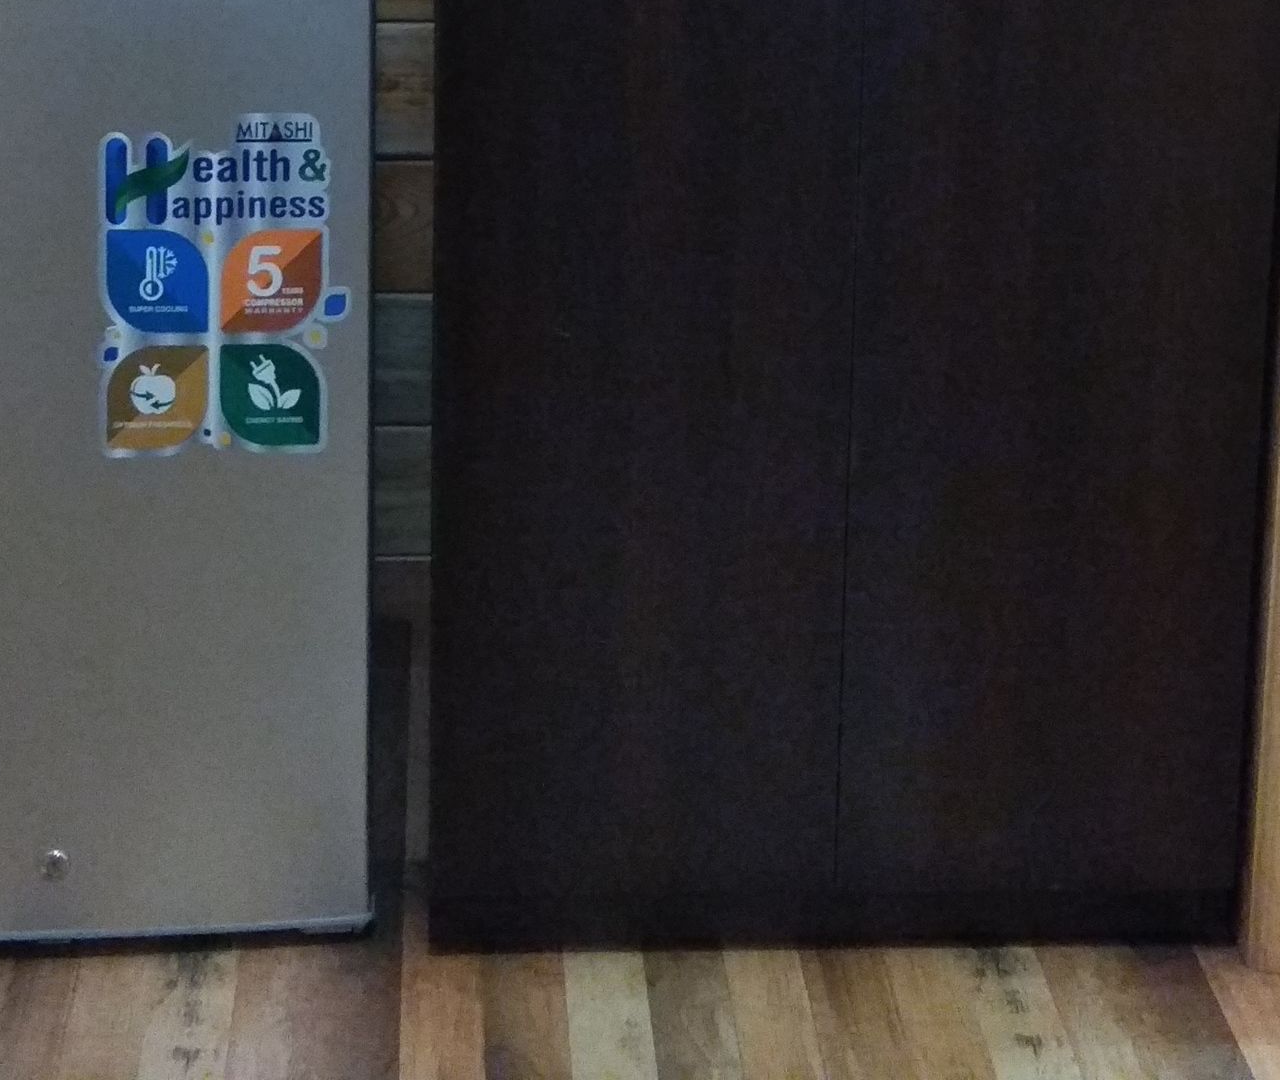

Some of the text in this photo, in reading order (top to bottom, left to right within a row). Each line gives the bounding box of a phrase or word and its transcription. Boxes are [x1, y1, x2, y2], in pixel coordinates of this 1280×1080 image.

[236, 122, 313, 141] MITASHI
[298, 148, 327, 183] &
[247, 245, 283, 298] 5
